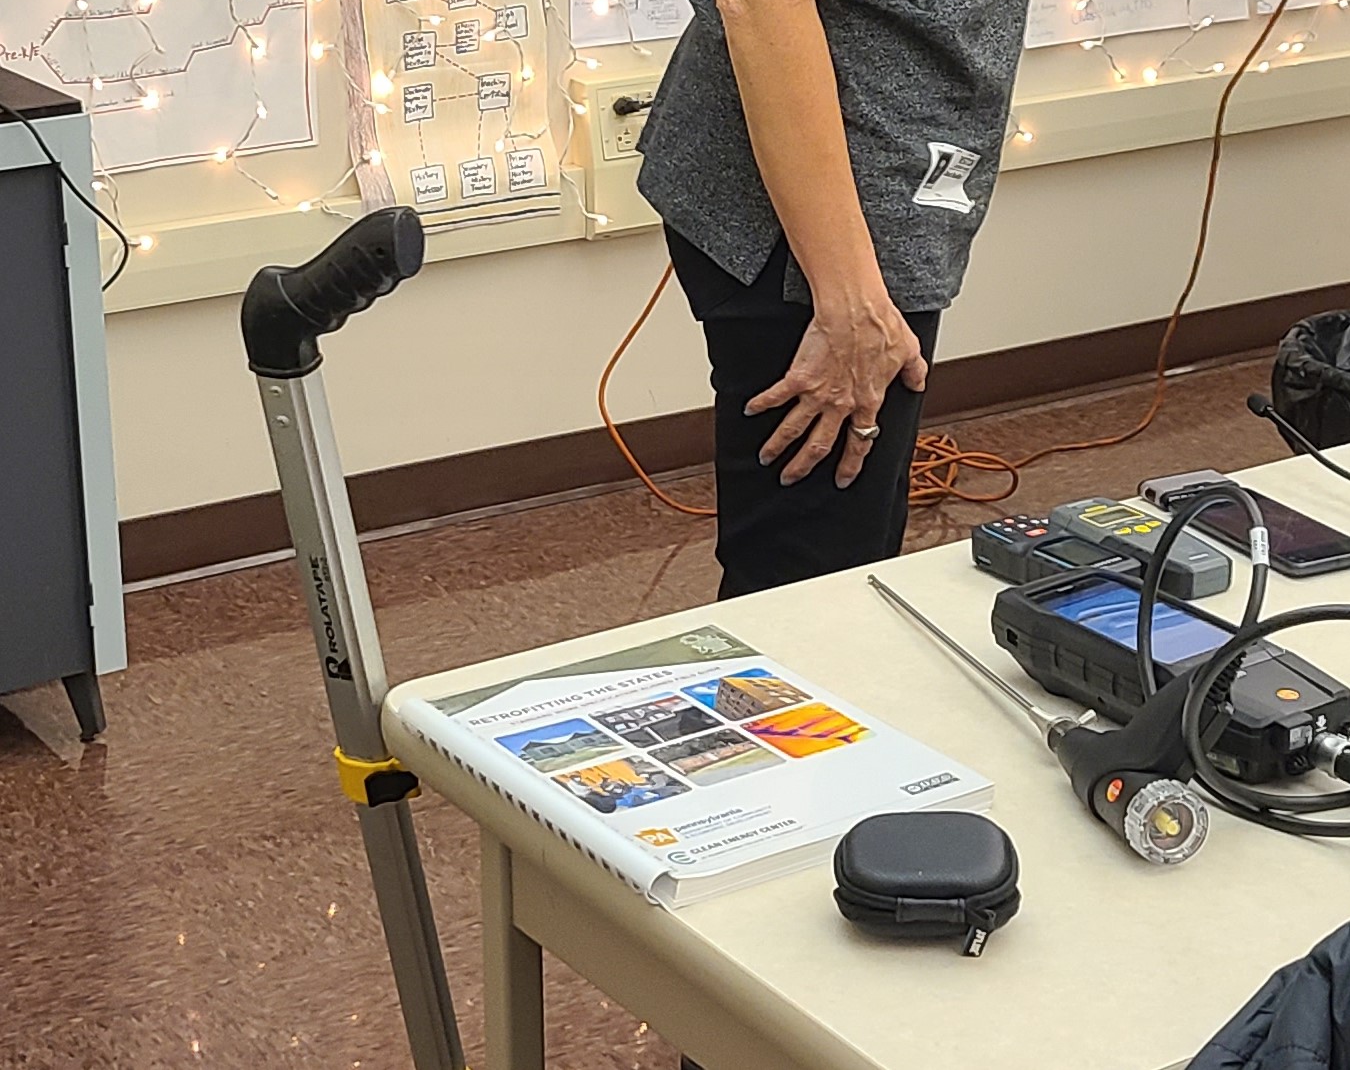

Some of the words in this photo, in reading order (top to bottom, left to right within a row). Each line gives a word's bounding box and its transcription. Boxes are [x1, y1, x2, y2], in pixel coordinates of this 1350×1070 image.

[309, 554, 339, 654] ROLATAPE
[468, 692, 584, 727] RETROFITTING
[587, 684, 617, 698] THE
[619, 669, 674, 692] STATES
[673, 806, 743, 833] pennsylvania
[689, 841, 724, 855] CLEAN
[724, 828, 759, 846] ENERGY
[759, 817, 797, 833] CENTER
[644, 833, 674, 845] PA
